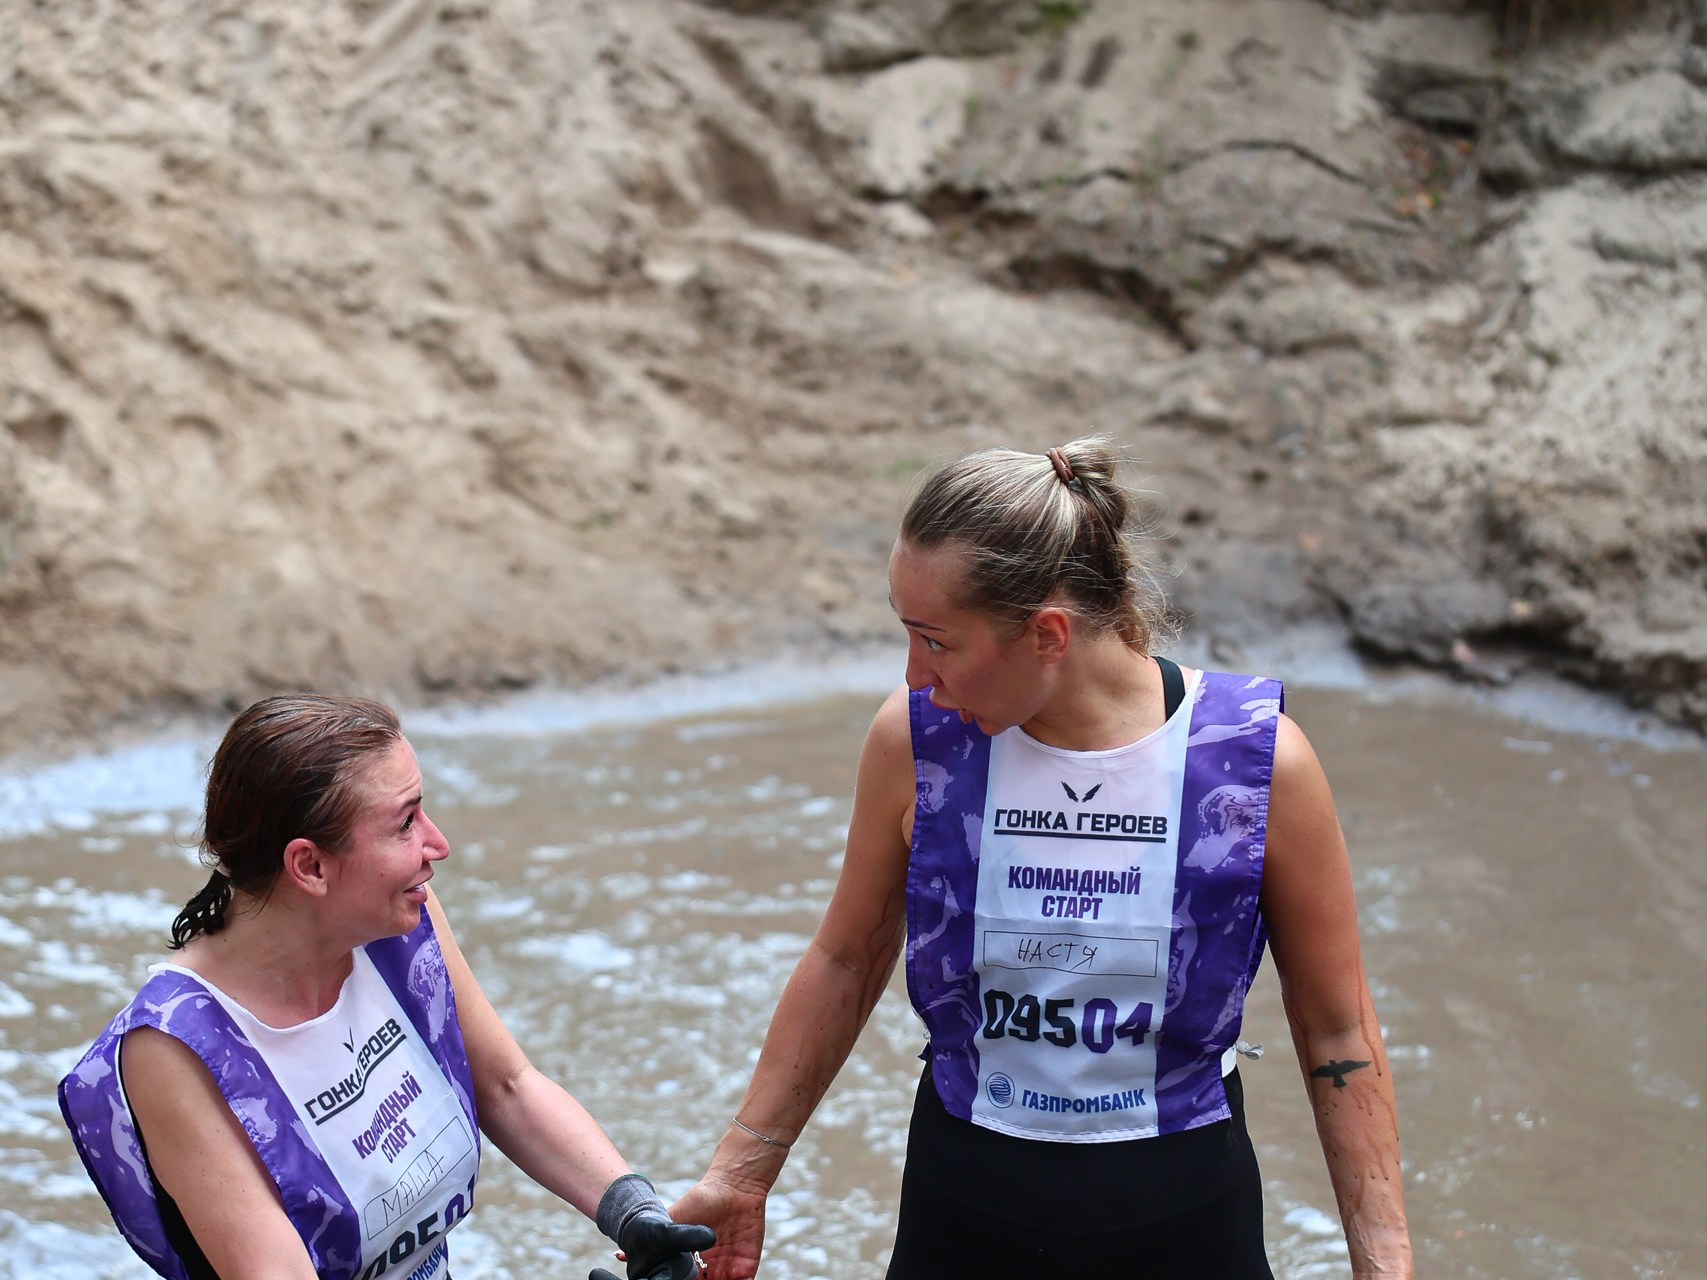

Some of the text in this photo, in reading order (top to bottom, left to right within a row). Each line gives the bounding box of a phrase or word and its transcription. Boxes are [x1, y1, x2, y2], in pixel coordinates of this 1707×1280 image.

[994, 808, 1168, 835] ГОНКА ГЕРОЕВ
[1008, 865, 1141, 896] КОМАНДНЫЙ
[1041, 895, 1103, 920] СТАРТ
[982, 988, 1152, 1054] 09504
[304, 1067, 362, 1119] ГОНКА
[1021, 1088, 1147, 1114] ГАЗПРОМБАНК
[380, 1117, 416, 1164] СТАРТ
